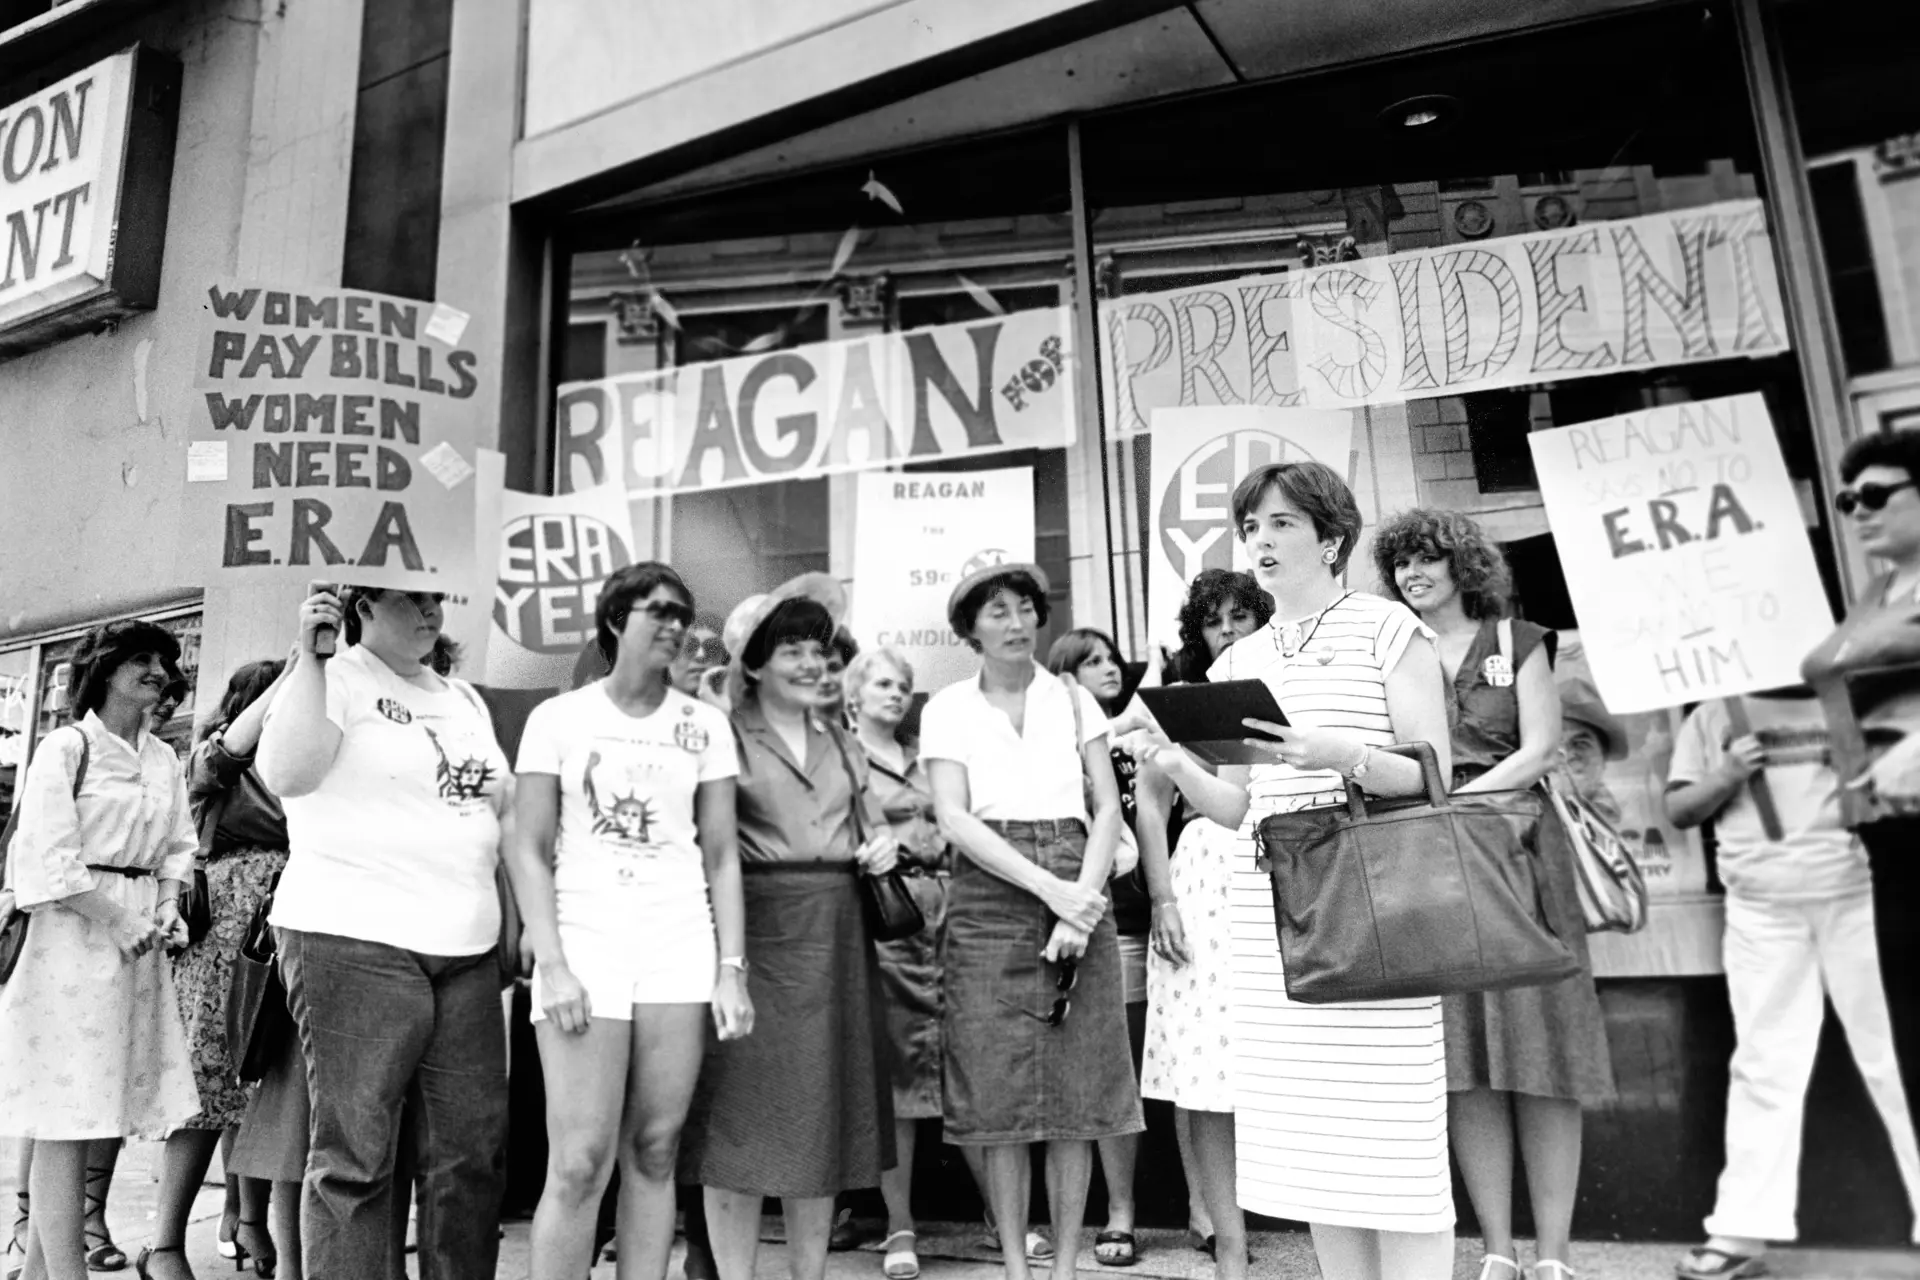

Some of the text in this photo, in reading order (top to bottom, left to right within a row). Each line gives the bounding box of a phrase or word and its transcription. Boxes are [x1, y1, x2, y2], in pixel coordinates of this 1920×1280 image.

[0, 78, 93, 184] ON
[208, 284, 417, 340] WOMEN
[208, 330, 478, 399] PAY BILLS
[557, 322, 1004, 497] REAGAN
[1106, 210, 1782, 431] PRESIDENT
[205, 392, 420, 445] WOMEN
[1568, 398, 1742, 471] REAGAN
[252, 441, 412, 491] NEED
[893, 480, 985, 500] REAGAN
[1657, 459, 1699, 497] NO
[1704, 452, 1752, 484] TO
[222, 497, 438, 572] E.R.A.
[499, 514, 614, 583] ERA
[1601, 482, 1765, 560] E.R.A.
[1636, 544, 1742, 602] WE
[1731, 589, 1781, 625] TO
[877, 628, 967, 648] CANDID
[1654, 638, 1754, 694] HIM
